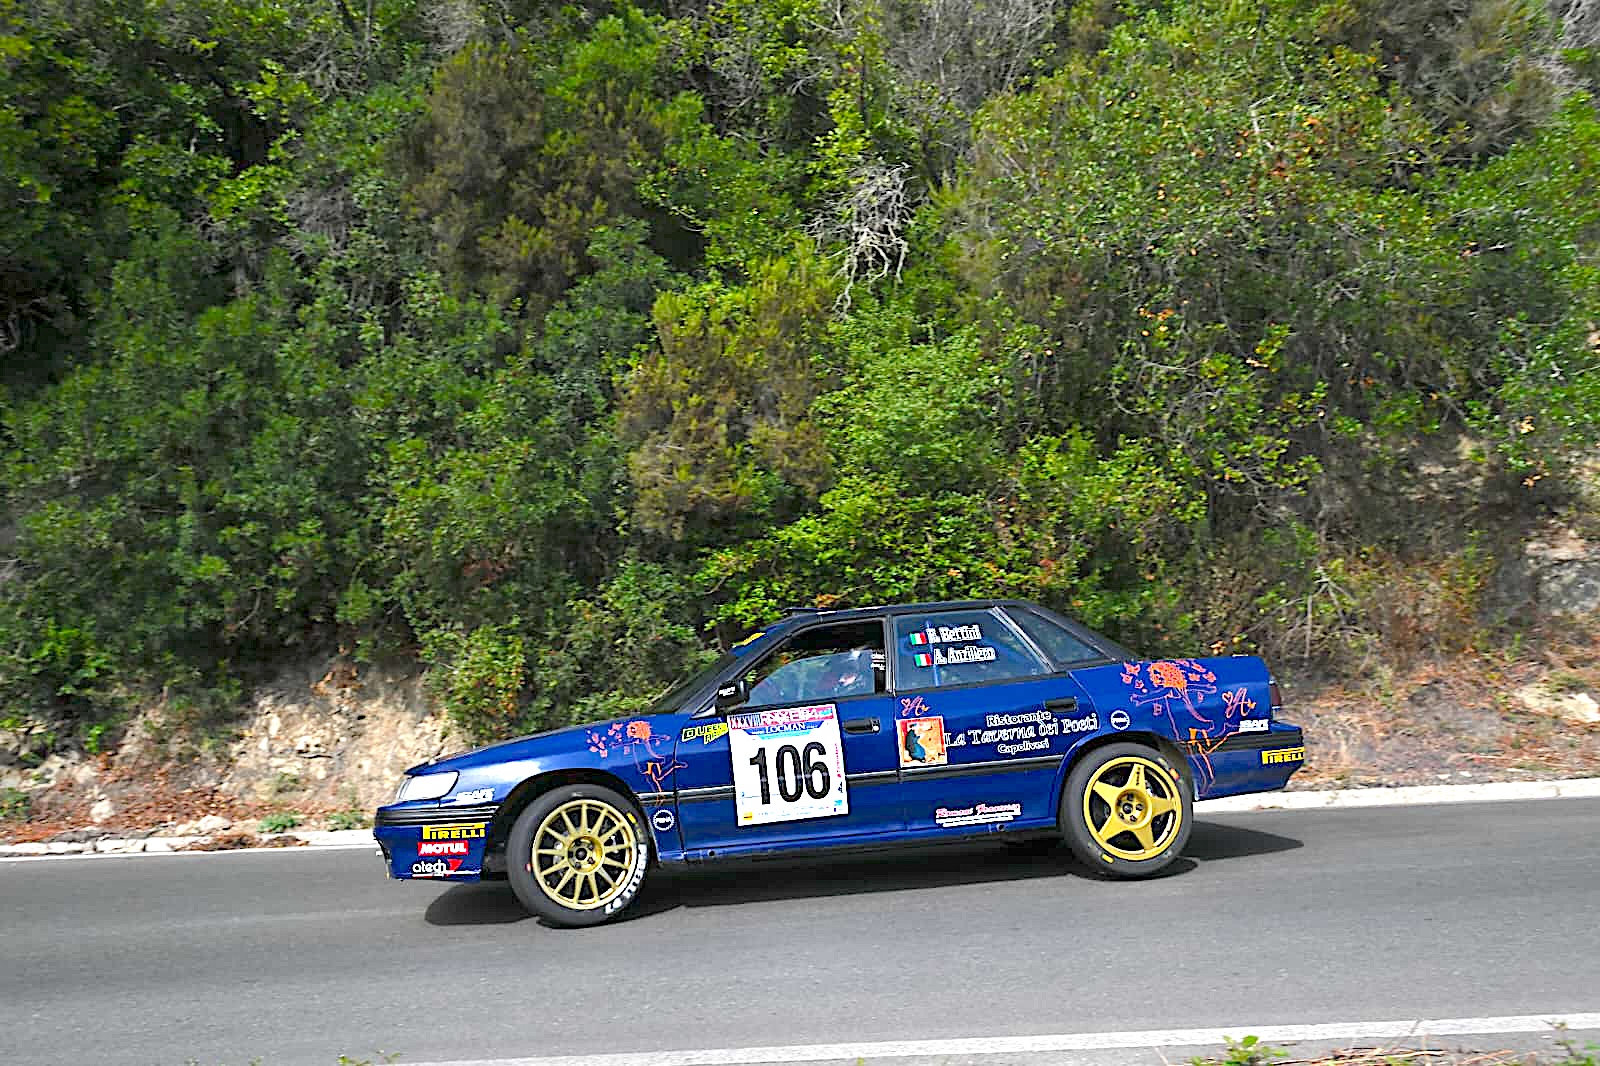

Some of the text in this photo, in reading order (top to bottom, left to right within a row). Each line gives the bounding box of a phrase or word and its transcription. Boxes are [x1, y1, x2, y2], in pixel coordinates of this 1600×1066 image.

[986, 711, 1052, 727] Ristorante
[765, 723, 806, 735] LOCMAN
[944, 732, 966, 747] La
[968, 724, 1036, 745] Taverna
[1062, 713, 1099, 734] Poeti
[749, 741, 830, 805] 106
[422, 823, 486, 840] PIRELLI
[420, 842, 467, 854] MOTUL
